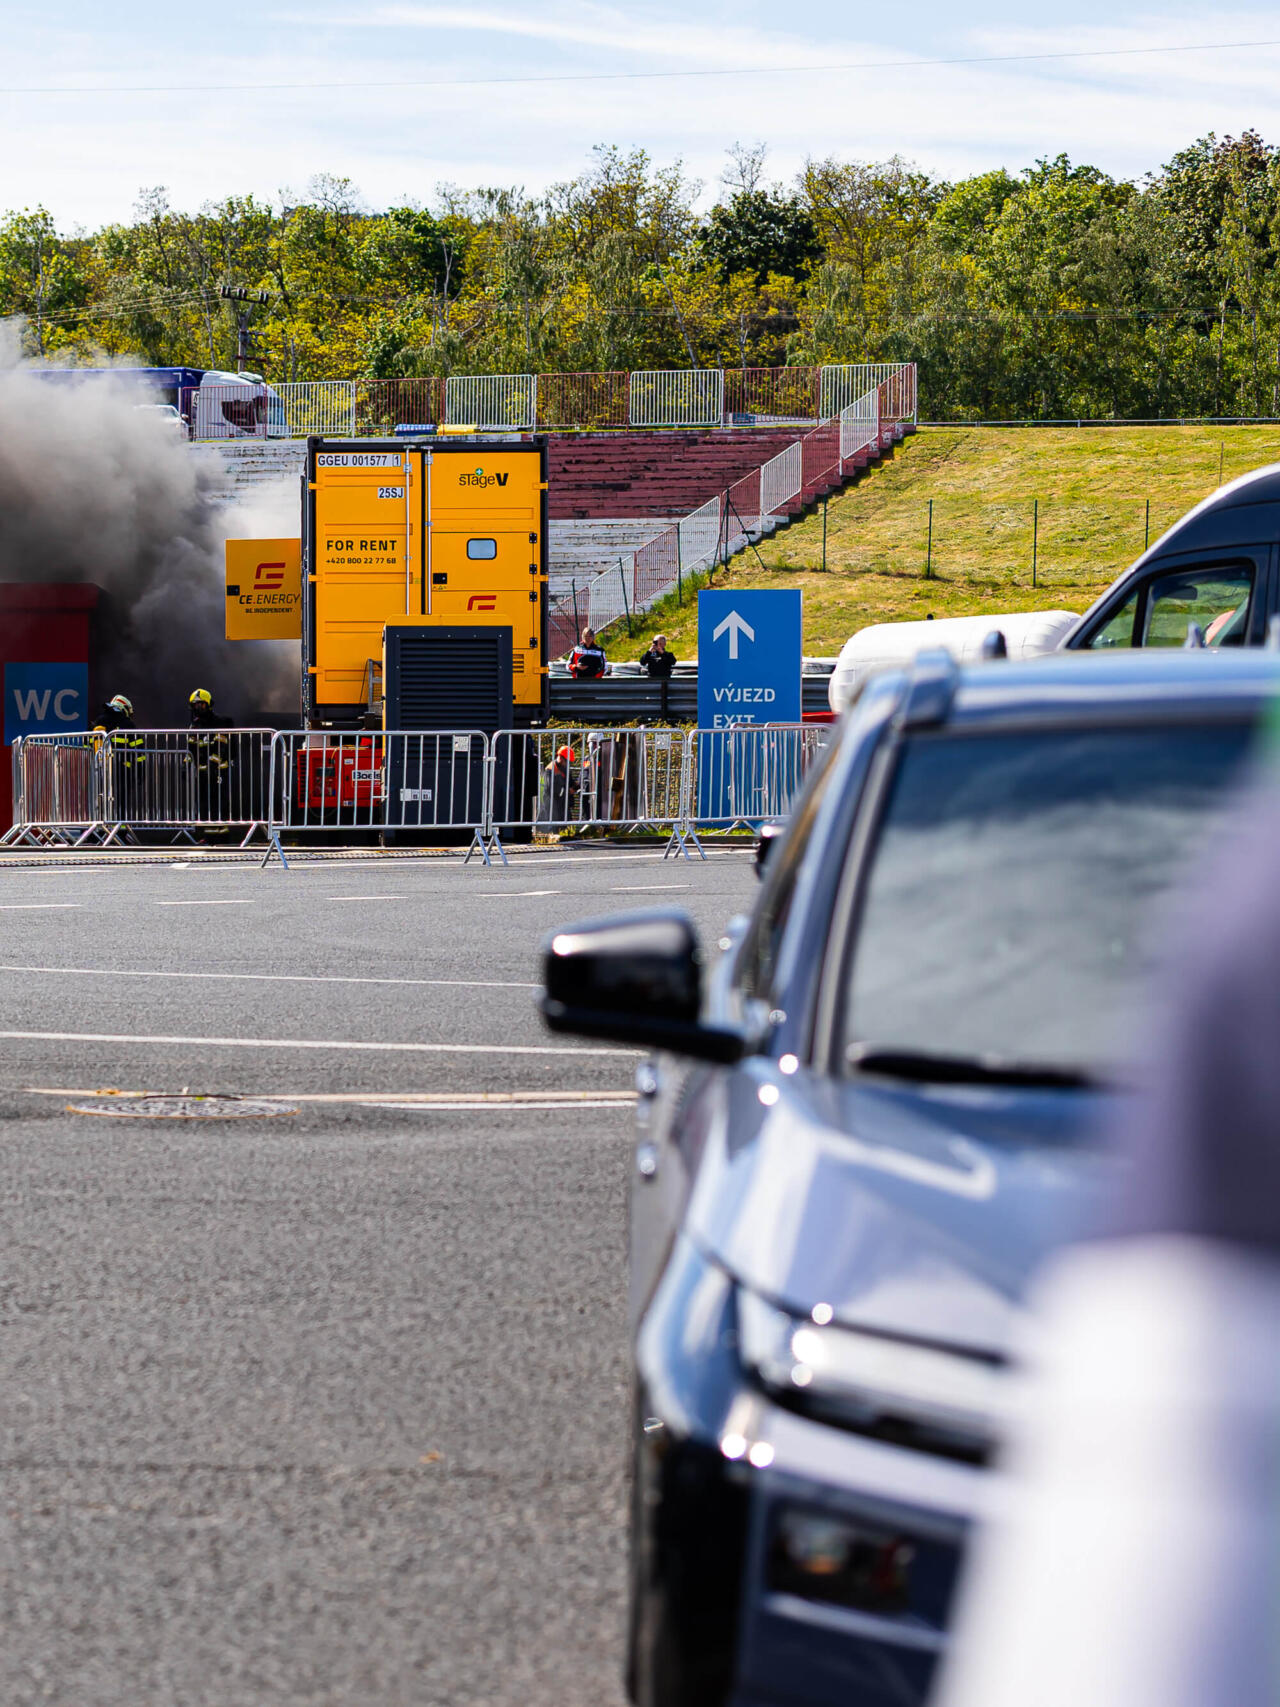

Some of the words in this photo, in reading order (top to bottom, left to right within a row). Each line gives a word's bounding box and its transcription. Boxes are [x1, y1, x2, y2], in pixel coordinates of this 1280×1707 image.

[317, 455, 349, 466] GGEU
[352, 455, 387, 466] 001577
[394, 455, 400, 466] 1
[378, 488, 404, 498] 25SJ
[326, 540, 355, 551] FOR
[359, 540, 398, 551] RENT
[239, 593, 300, 605] CE.ENERGY
[713, 683, 776, 703] VÝJEZD
[12, 689, 80, 721] WC
[713, 714, 756, 729] EXIT
